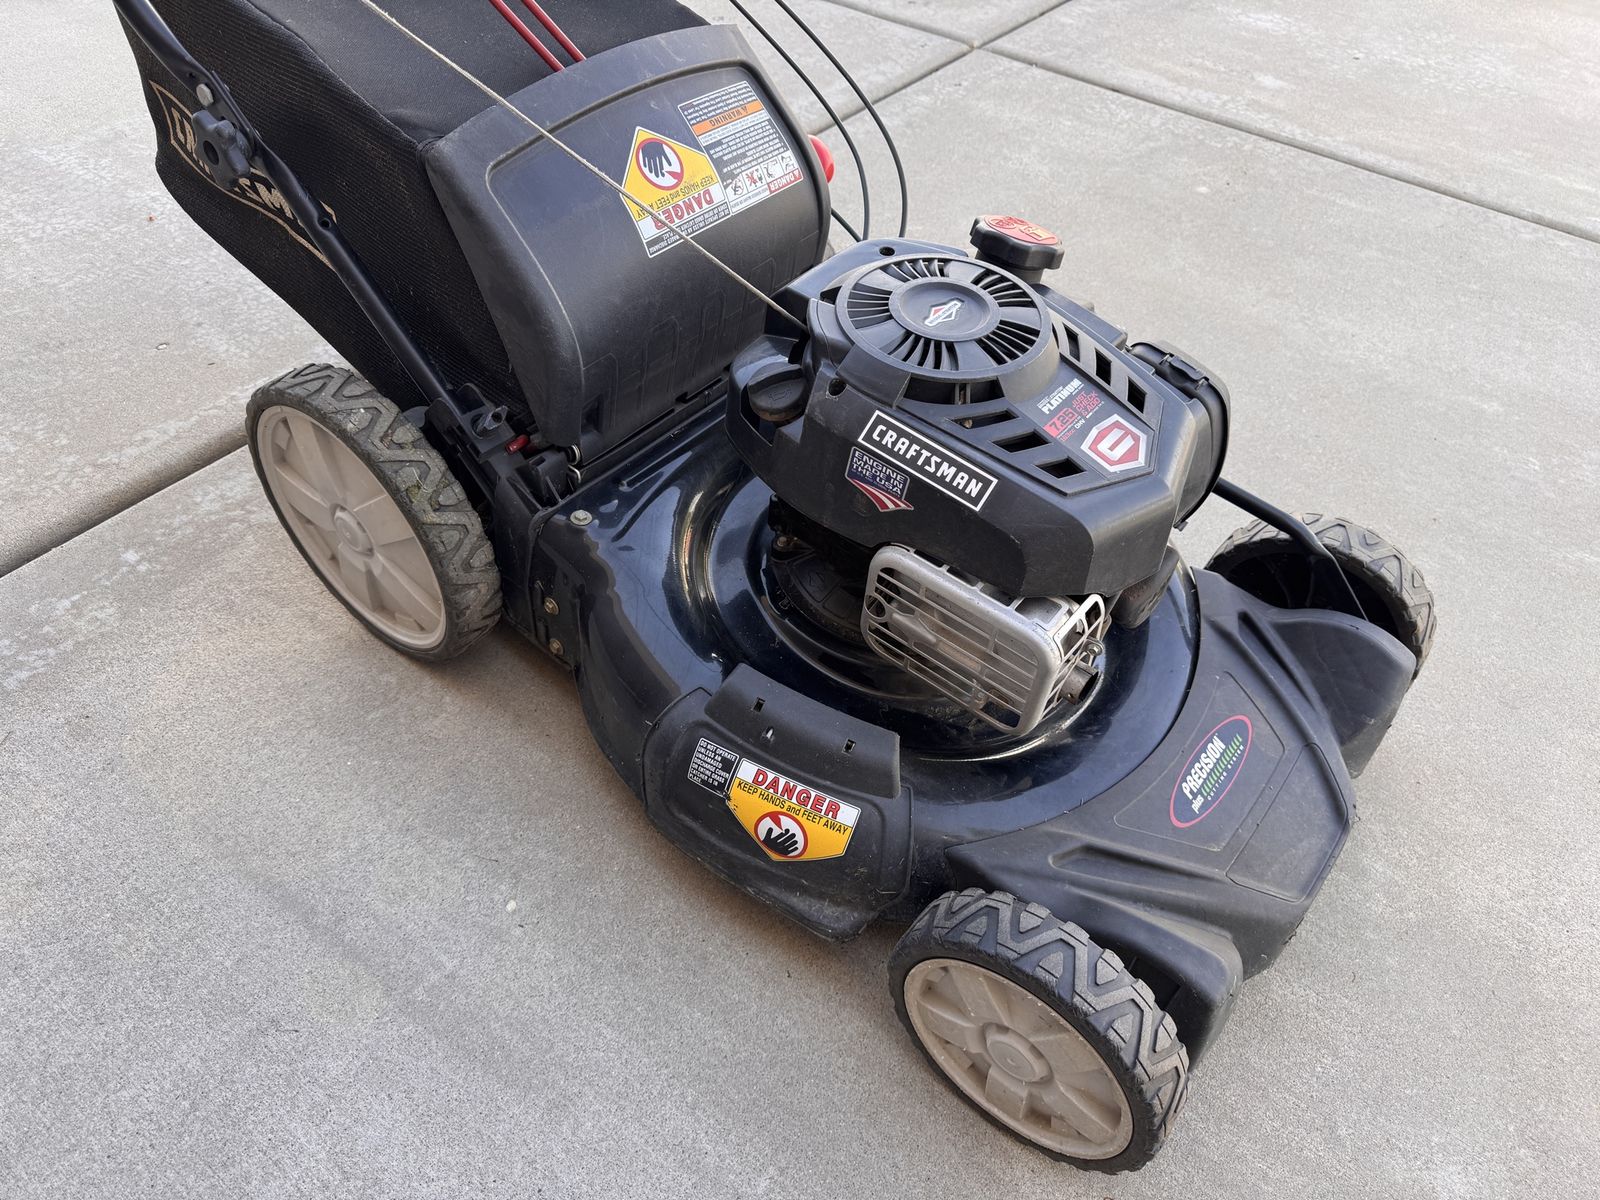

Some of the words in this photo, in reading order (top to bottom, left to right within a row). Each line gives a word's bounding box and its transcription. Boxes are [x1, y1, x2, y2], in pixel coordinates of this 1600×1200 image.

[708, 107, 741, 127] WARNING
[679, 180, 700, 196] HANDS
[699, 174, 714, 187] KEEP
[768, 172, 794, 191] DANGER
[653, 195, 670, 209] FEET
[669, 190, 680, 201] and
[635, 202, 655, 218] AAY
[1041, 377, 1082, 414] PLATINUM
[1070, 390, 1087, 407] JUST
[1075, 390, 1098, 411] CHECK
[1086, 397, 1100, 411] ADD
[1048, 408, 1075, 431] 7.25
[854, 450, 905, 483] ENGINE
[873, 425, 983, 498] CRAFTSMAN
[852, 457, 887, 480] MADE
[890, 478, 902, 488] IN
[852, 462, 873, 478] THE
[875, 476, 901, 494] USA
[694, 751, 722, 768] UNDAMAGED
[697, 746, 714, 757] UNLESS
[706, 743, 716, 751] NOT
[715, 748, 736, 761] OPERATE
[690, 768, 708, 780] CATCHER
[693, 757, 715, 771] DISCHARGE
[715, 768, 729, 778] COVER
[1182, 736, 1226, 800] PRECISION
[1208, 772, 1227, 800] CUTTING
[1228, 745, 1244, 769] SYSTEM
[711, 772, 725, 783] GRASS
[752, 769, 841, 819] DANGER
[737, 781, 758, 795] KEEP
[759, 791, 785, 809] HANDS
[786, 804, 799, 815] and
[802, 809, 823, 824] FEET
[823, 820, 848, 835] AWAY
[1191, 795, 1204, 814] plus
